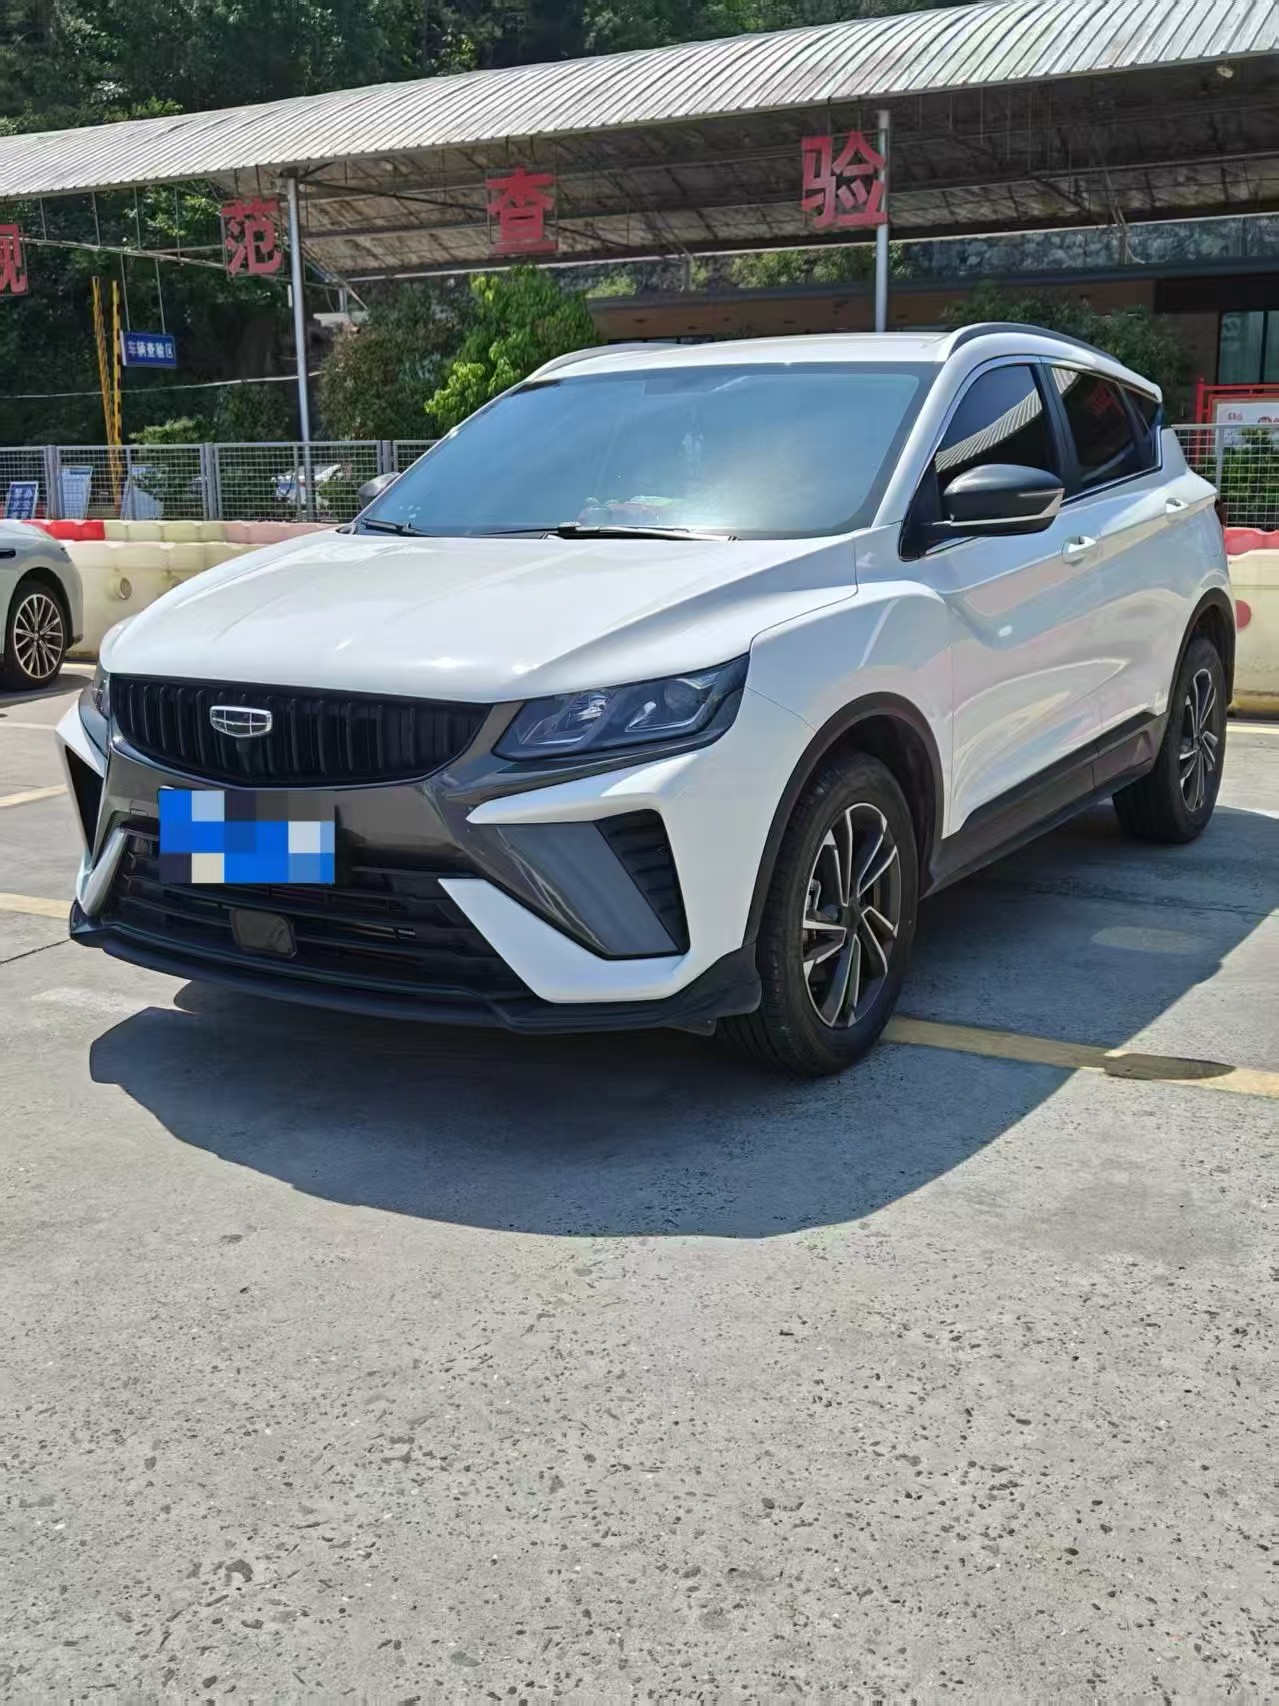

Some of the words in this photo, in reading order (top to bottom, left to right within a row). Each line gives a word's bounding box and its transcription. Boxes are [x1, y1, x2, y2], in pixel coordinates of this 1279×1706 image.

[221, 198, 281, 274] 范
[486, 167, 557, 253] 查
[801, 131, 888, 229] 验
[127, 340, 174, 359] 车辆查验区
